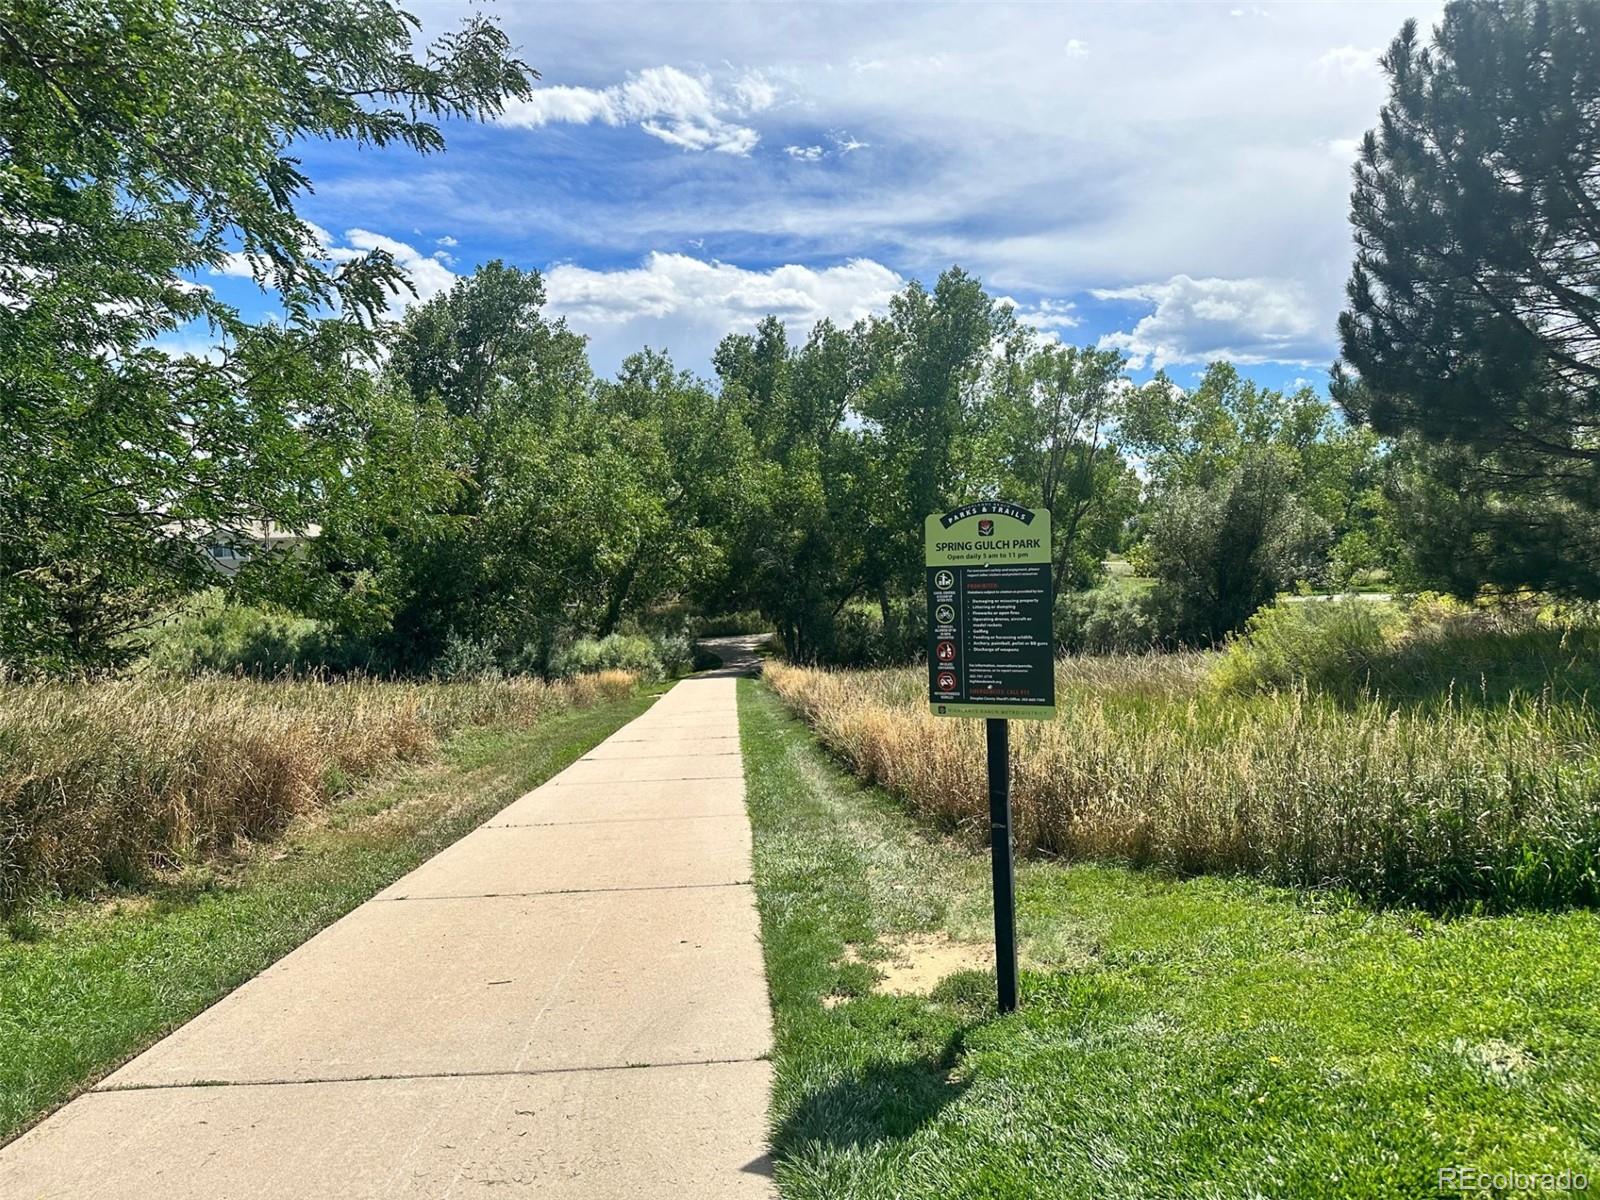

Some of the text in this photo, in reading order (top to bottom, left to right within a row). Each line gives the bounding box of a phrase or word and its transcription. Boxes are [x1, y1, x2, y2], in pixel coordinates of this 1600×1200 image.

[948, 508, 977, 524] PARKS
[992, 506, 1026, 520] TRAILS
[936, 539, 1040, 551] SPRING GULCH PARK
